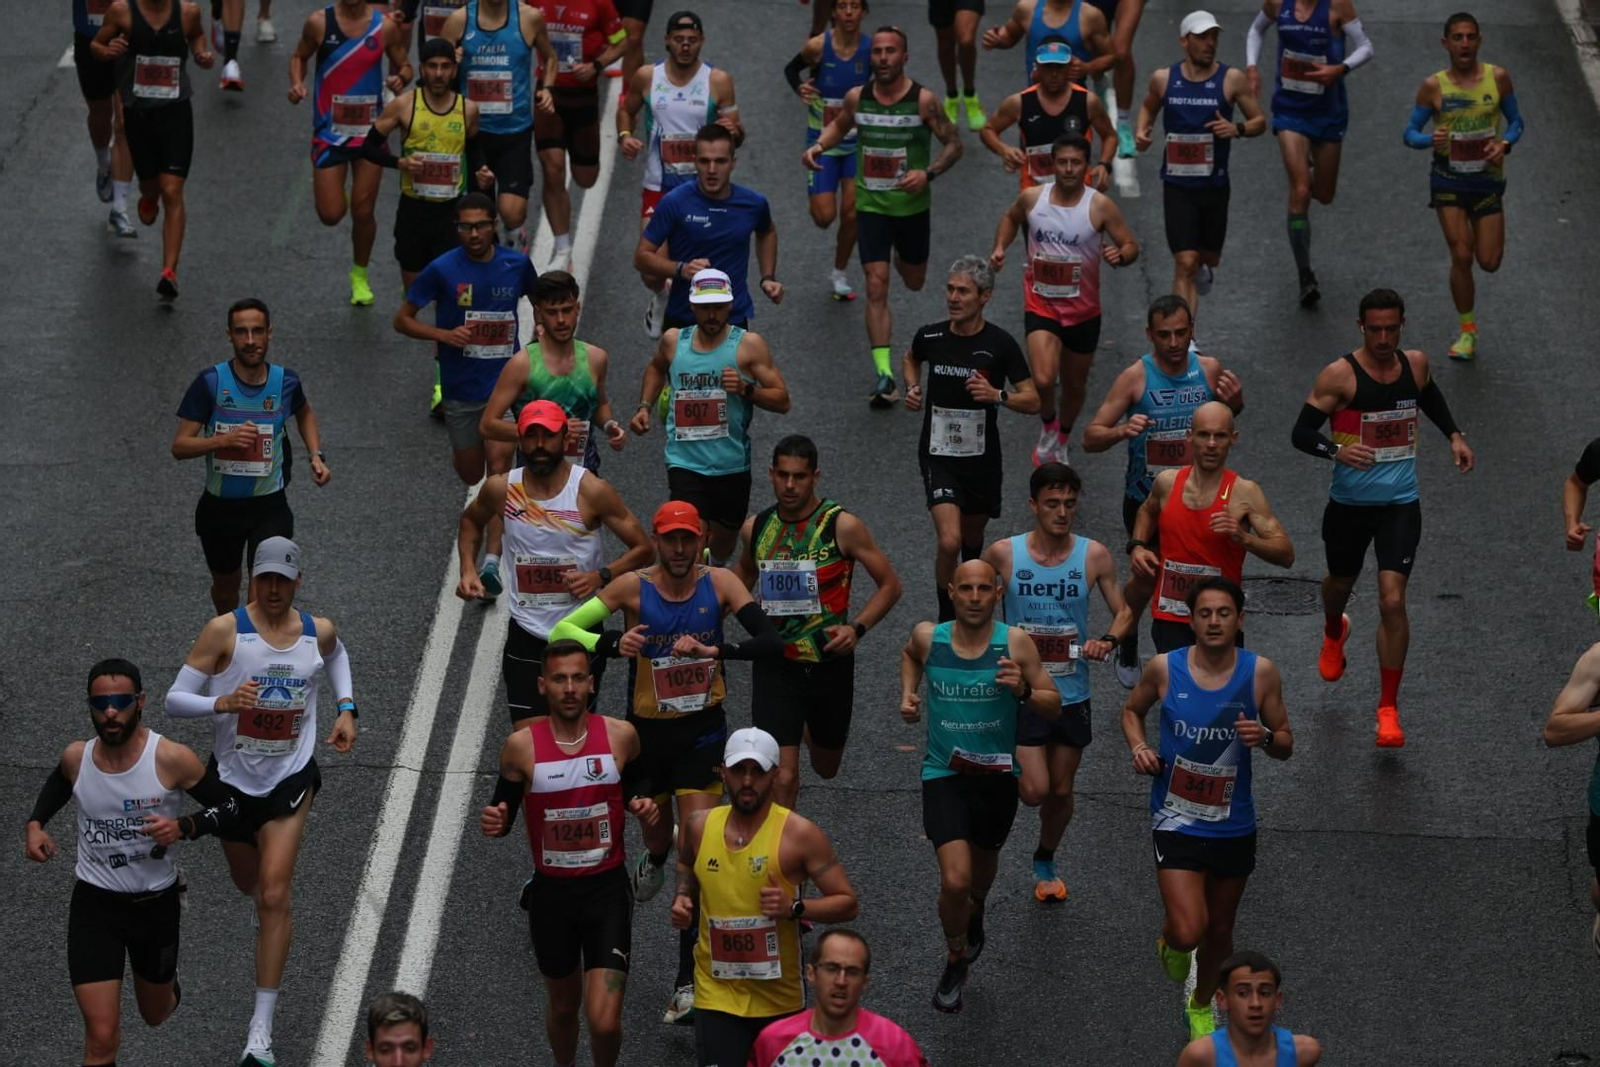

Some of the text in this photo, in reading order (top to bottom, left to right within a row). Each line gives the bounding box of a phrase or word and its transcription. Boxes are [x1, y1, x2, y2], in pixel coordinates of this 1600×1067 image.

[477, 44, 506, 54] ITALIA
[471, 56, 510, 66] SIMONE
[1168, 96, 1219, 106] TROTASIERRA
[491, 286, 514, 297] USC
[1179, 391, 1208, 404] ULSA
[684, 403, 709, 418] 607
[1159, 442, 1186, 458] 700
[767, 574, 800, 592] 1801
[1018, 578, 1078, 601] nerja
[1028, 602, 1073, 611] ATLETISMO
[664, 666, 705, 689] 1026
[252, 713, 285, 730] 492
[1185, 775, 1214, 796] 341
[552, 821, 594, 842] 1244
[722, 932, 755, 952] 868
